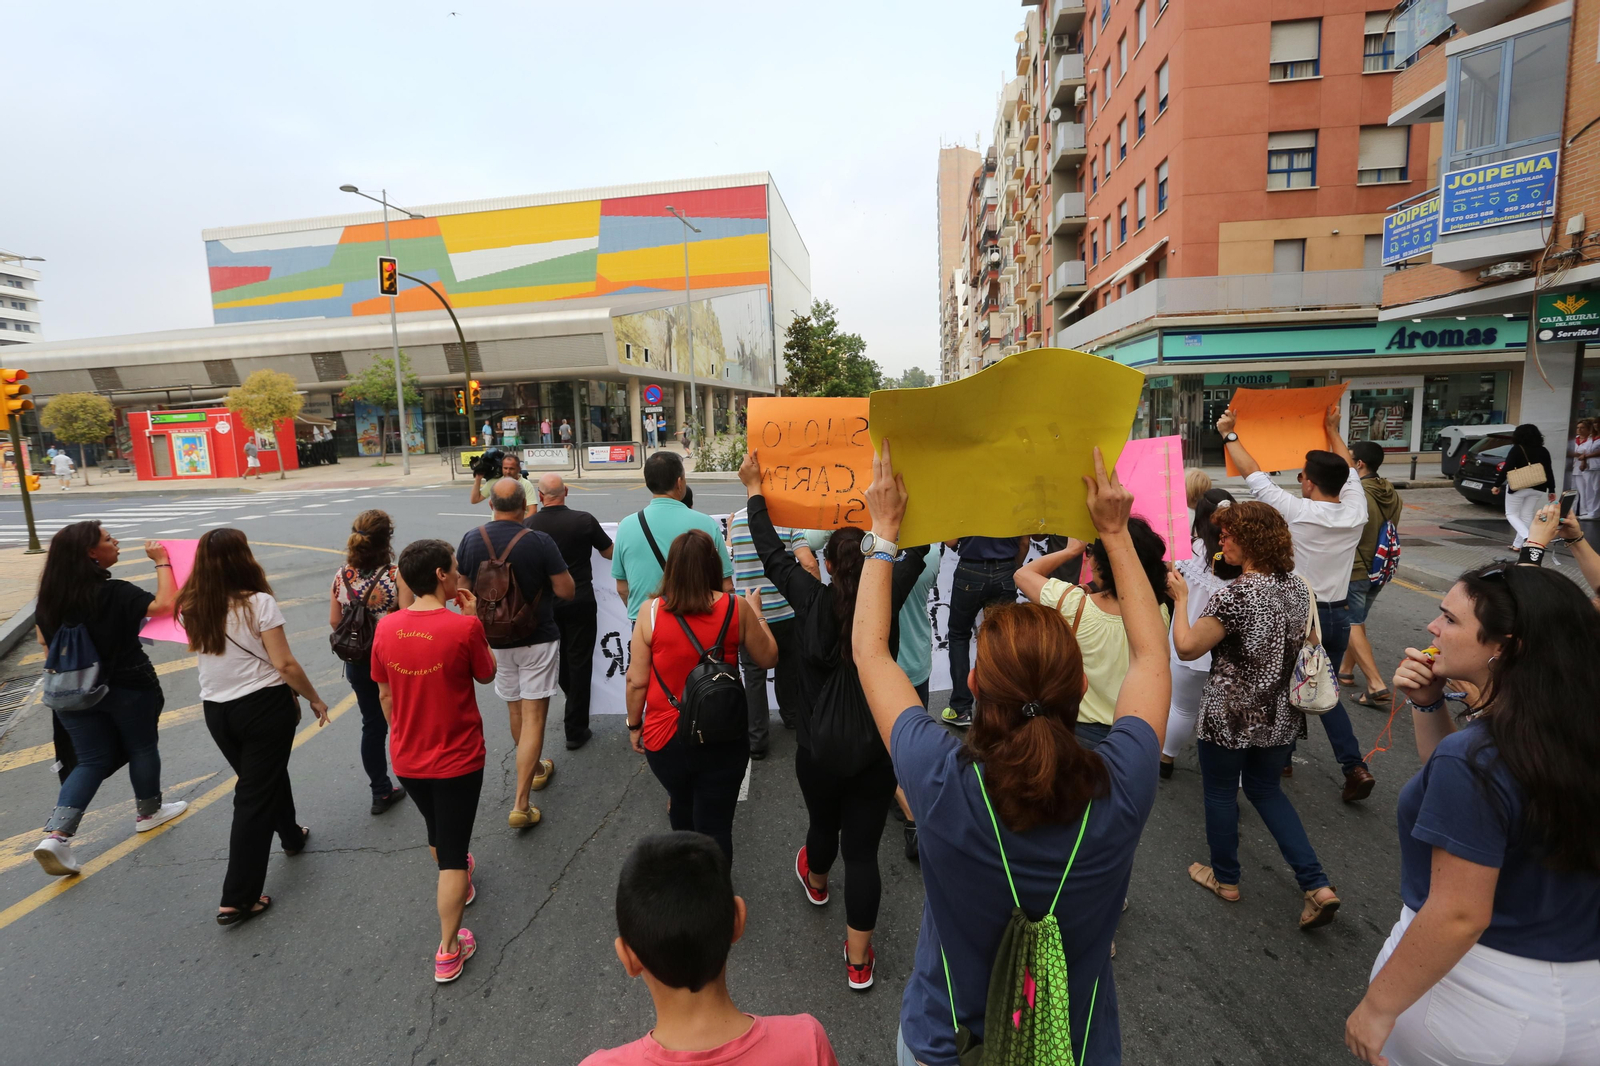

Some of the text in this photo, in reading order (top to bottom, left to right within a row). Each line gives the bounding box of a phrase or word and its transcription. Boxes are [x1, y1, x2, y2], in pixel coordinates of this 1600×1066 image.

[1448, 157, 1553, 189] JOIPEMA
[1455, 188, 1477, 196] AGENCIA
[1486, 181, 1511, 190] SEGUROS
[1512, 174, 1543, 184] VINCULADA
[1389, 199, 1440, 229] JOIPEM
[1565, 313, 1600, 321] RURAL
[1385, 326, 1498, 350] Aromas
[1557, 328, 1600, 338] ServiRed
[1221, 374, 1273, 385] Aromas
[387, 661, 444, 676] Armenteros
